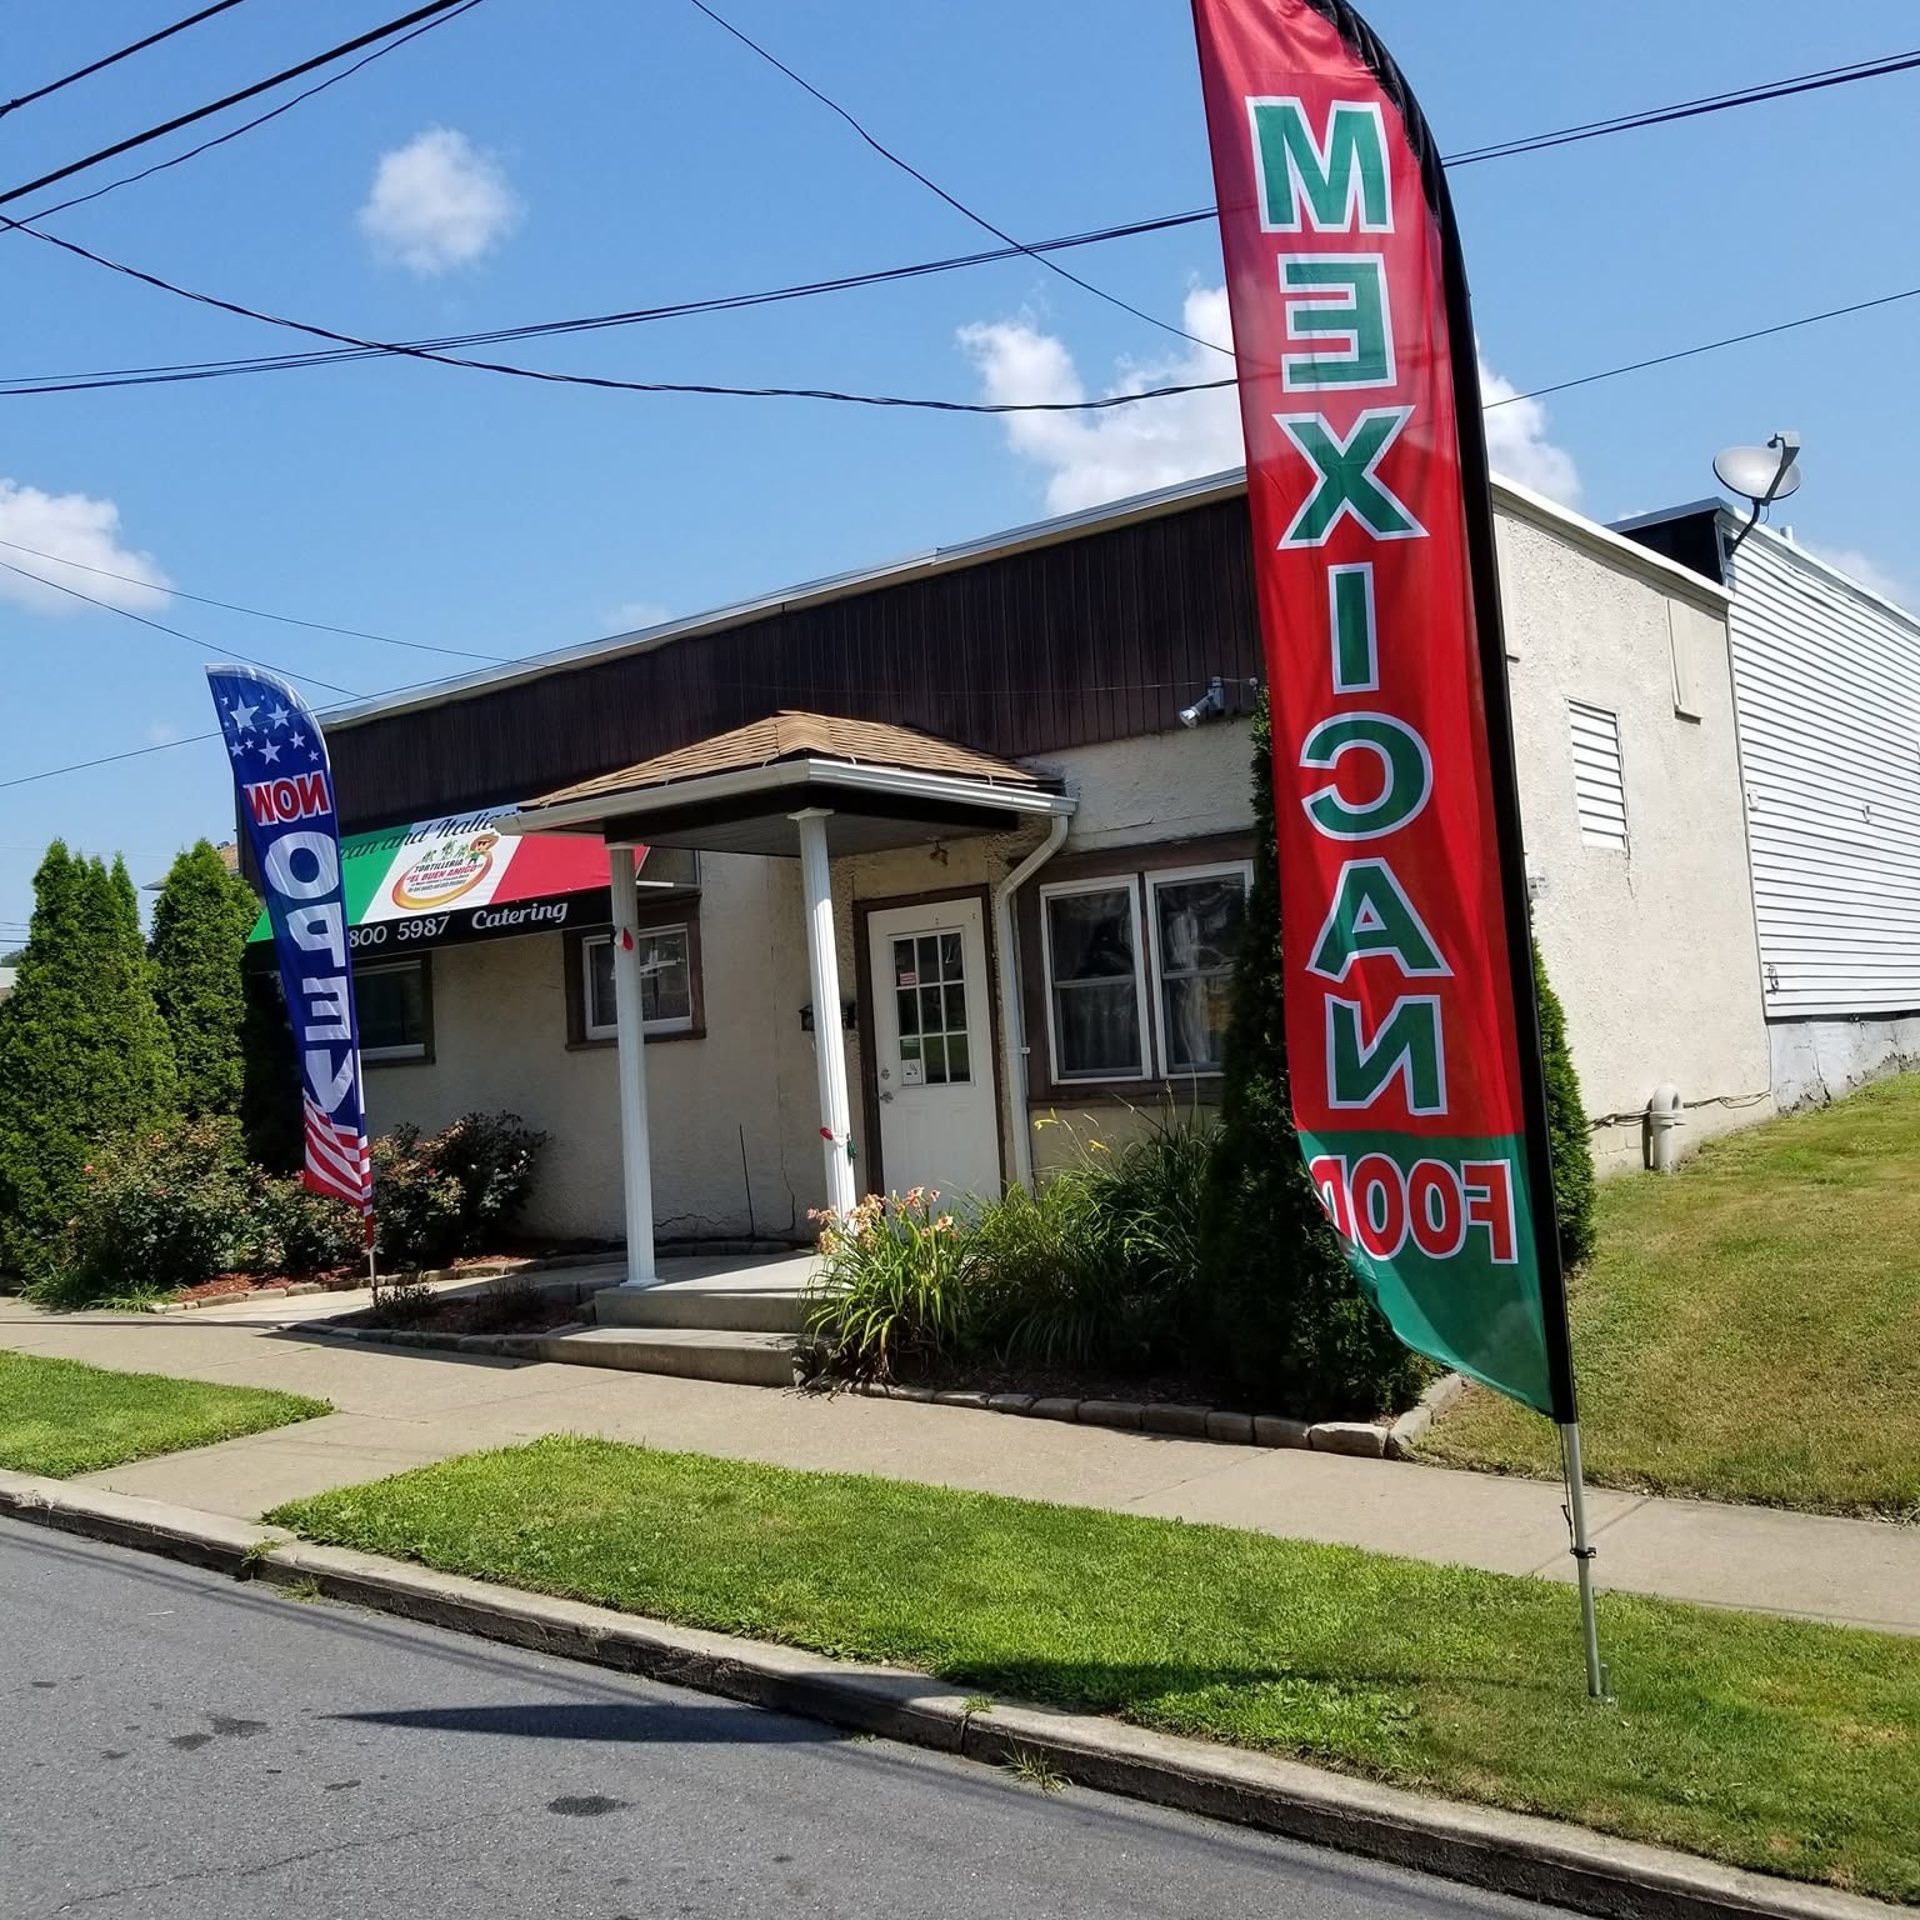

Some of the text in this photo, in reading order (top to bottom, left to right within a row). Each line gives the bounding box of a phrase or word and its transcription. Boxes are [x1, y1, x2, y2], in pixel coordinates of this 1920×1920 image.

[381, 823, 433, 851] and
[436, 811, 516, 839] Itali
[349, 915, 451, 948] 800 5987
[472, 902, 568, 930] Catering
